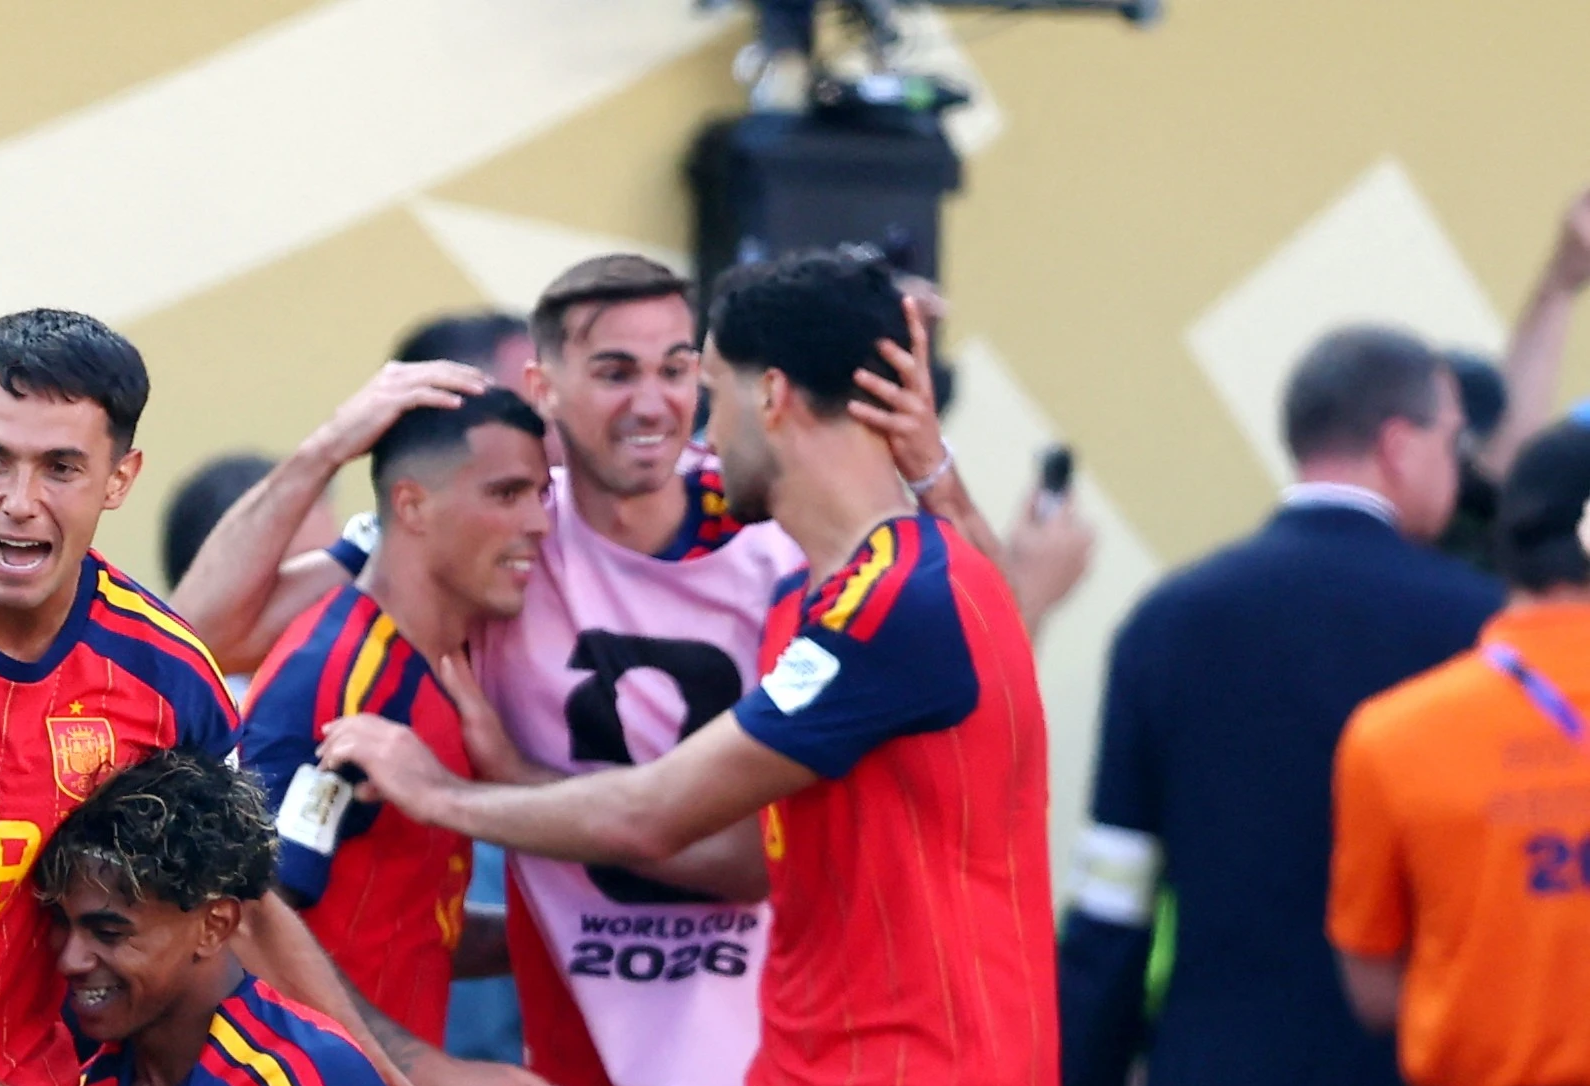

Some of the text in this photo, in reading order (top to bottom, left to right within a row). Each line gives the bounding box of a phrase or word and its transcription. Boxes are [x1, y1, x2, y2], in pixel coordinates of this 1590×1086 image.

[580, 913, 758, 939] WORLD CUP
[569, 939, 749, 983] 2026
